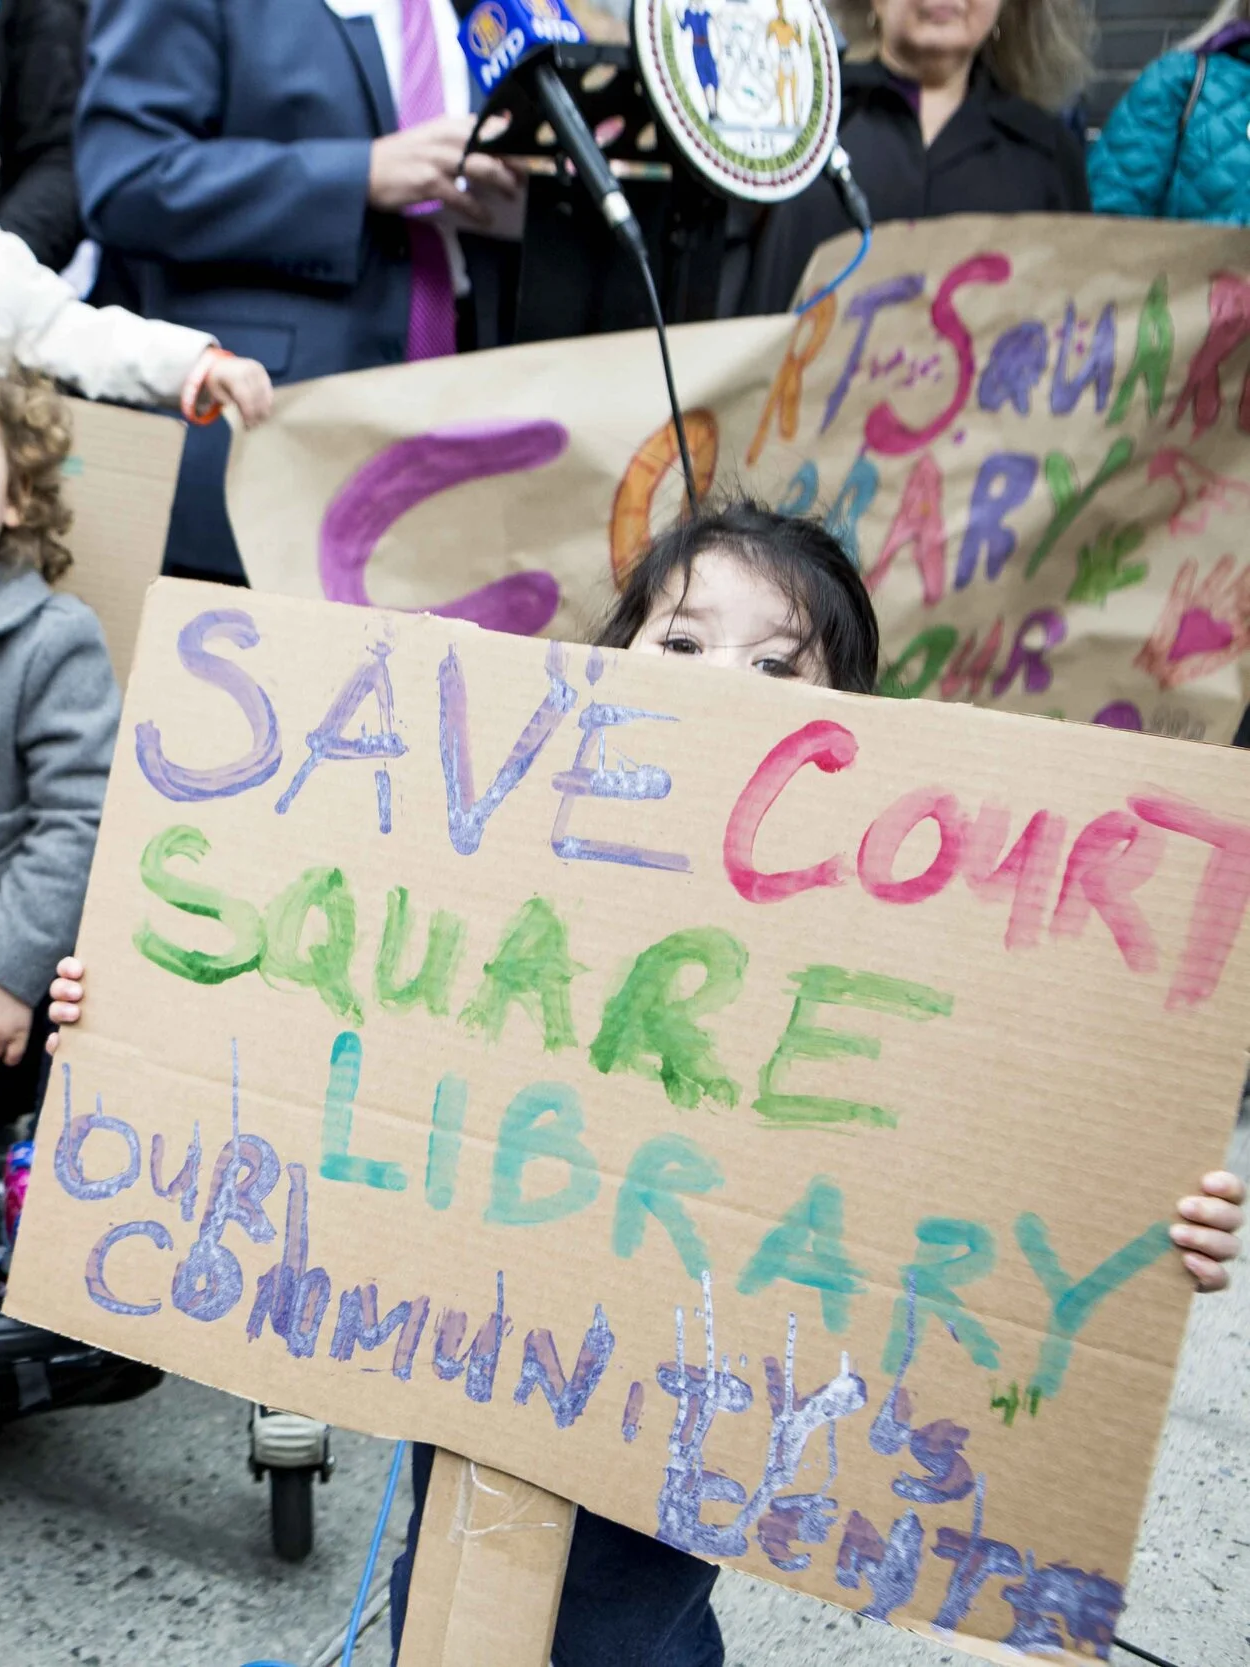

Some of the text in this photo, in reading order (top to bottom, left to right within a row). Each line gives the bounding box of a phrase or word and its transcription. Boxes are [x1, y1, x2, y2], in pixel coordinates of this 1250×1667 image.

[480, 27, 526, 89] NTD
[132, 823, 955, 1132] SQUARE
[135, 608, 1250, 1012] SAVE COURT
[320, 1031, 1175, 1398] LIBRARY
